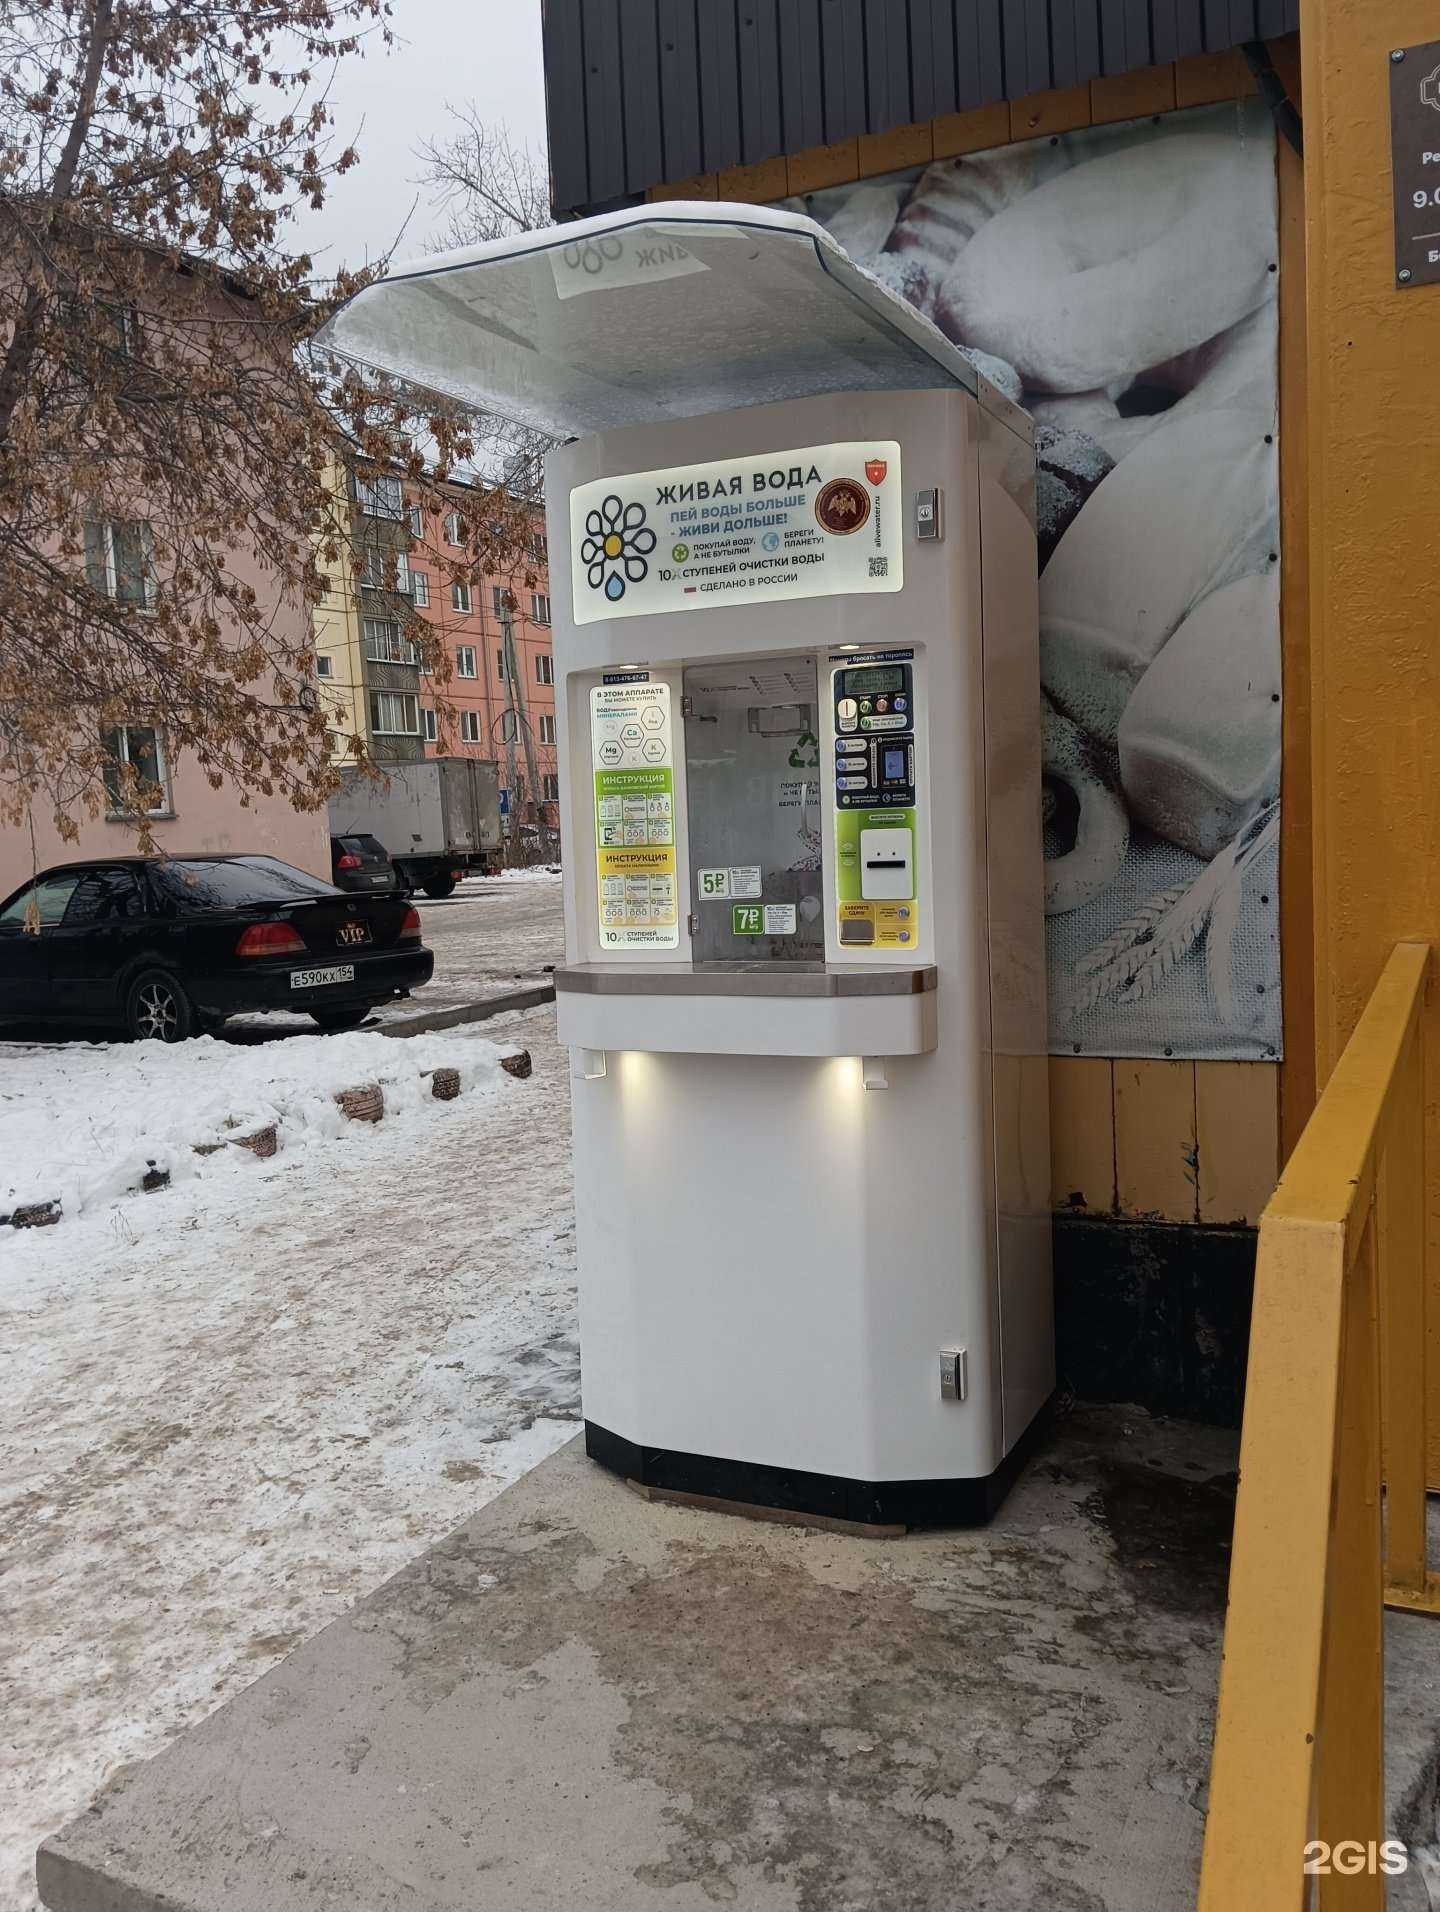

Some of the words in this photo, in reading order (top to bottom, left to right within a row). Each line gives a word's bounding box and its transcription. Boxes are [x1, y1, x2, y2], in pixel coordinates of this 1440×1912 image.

[656, 476, 742, 505] ЖИВАЯ
[752, 465, 822, 492] ВОДА
[670, 507, 697, 523] ПЕЙ
[701, 503, 742, 519] ВОДЫ
[746, 494, 806, 513] БОЛЬШЕ
[678, 521, 720, 538] ЖИВИ
[724, 513, 788, 534] ДОЛЬШЕ!
[784, 529, 814, 539] БЕРЕГИ
[693, 539, 731, 551] ПОКУПАЙ
[733, 537, 756, 547] ВОДУ,
[784, 537, 824, 548] ПЛАНЕТУ!
[702, 551, 711, 559] НЕ
[712, 547, 750, 558] БУТЫЛКИ
[683, 562, 736, 578] СТУПЕНЕЙ
[739, 558, 789, 571] ОЧИСТКИ
[792, 553, 825, 566] ВОДЫ
[699, 579, 746, 592] СДЕЛАНО
[749, 578, 756, 586] В
[759, 573, 798, 585] РОССИИ
[625, 688, 664, 696] АППАРАТЕ
[602, 774, 665, 785] ИНСТРУКЦИЯ
[606, 853, 668, 863] ИНСТРУКЦИЯ
[339, 928, 364, 943] VIP
